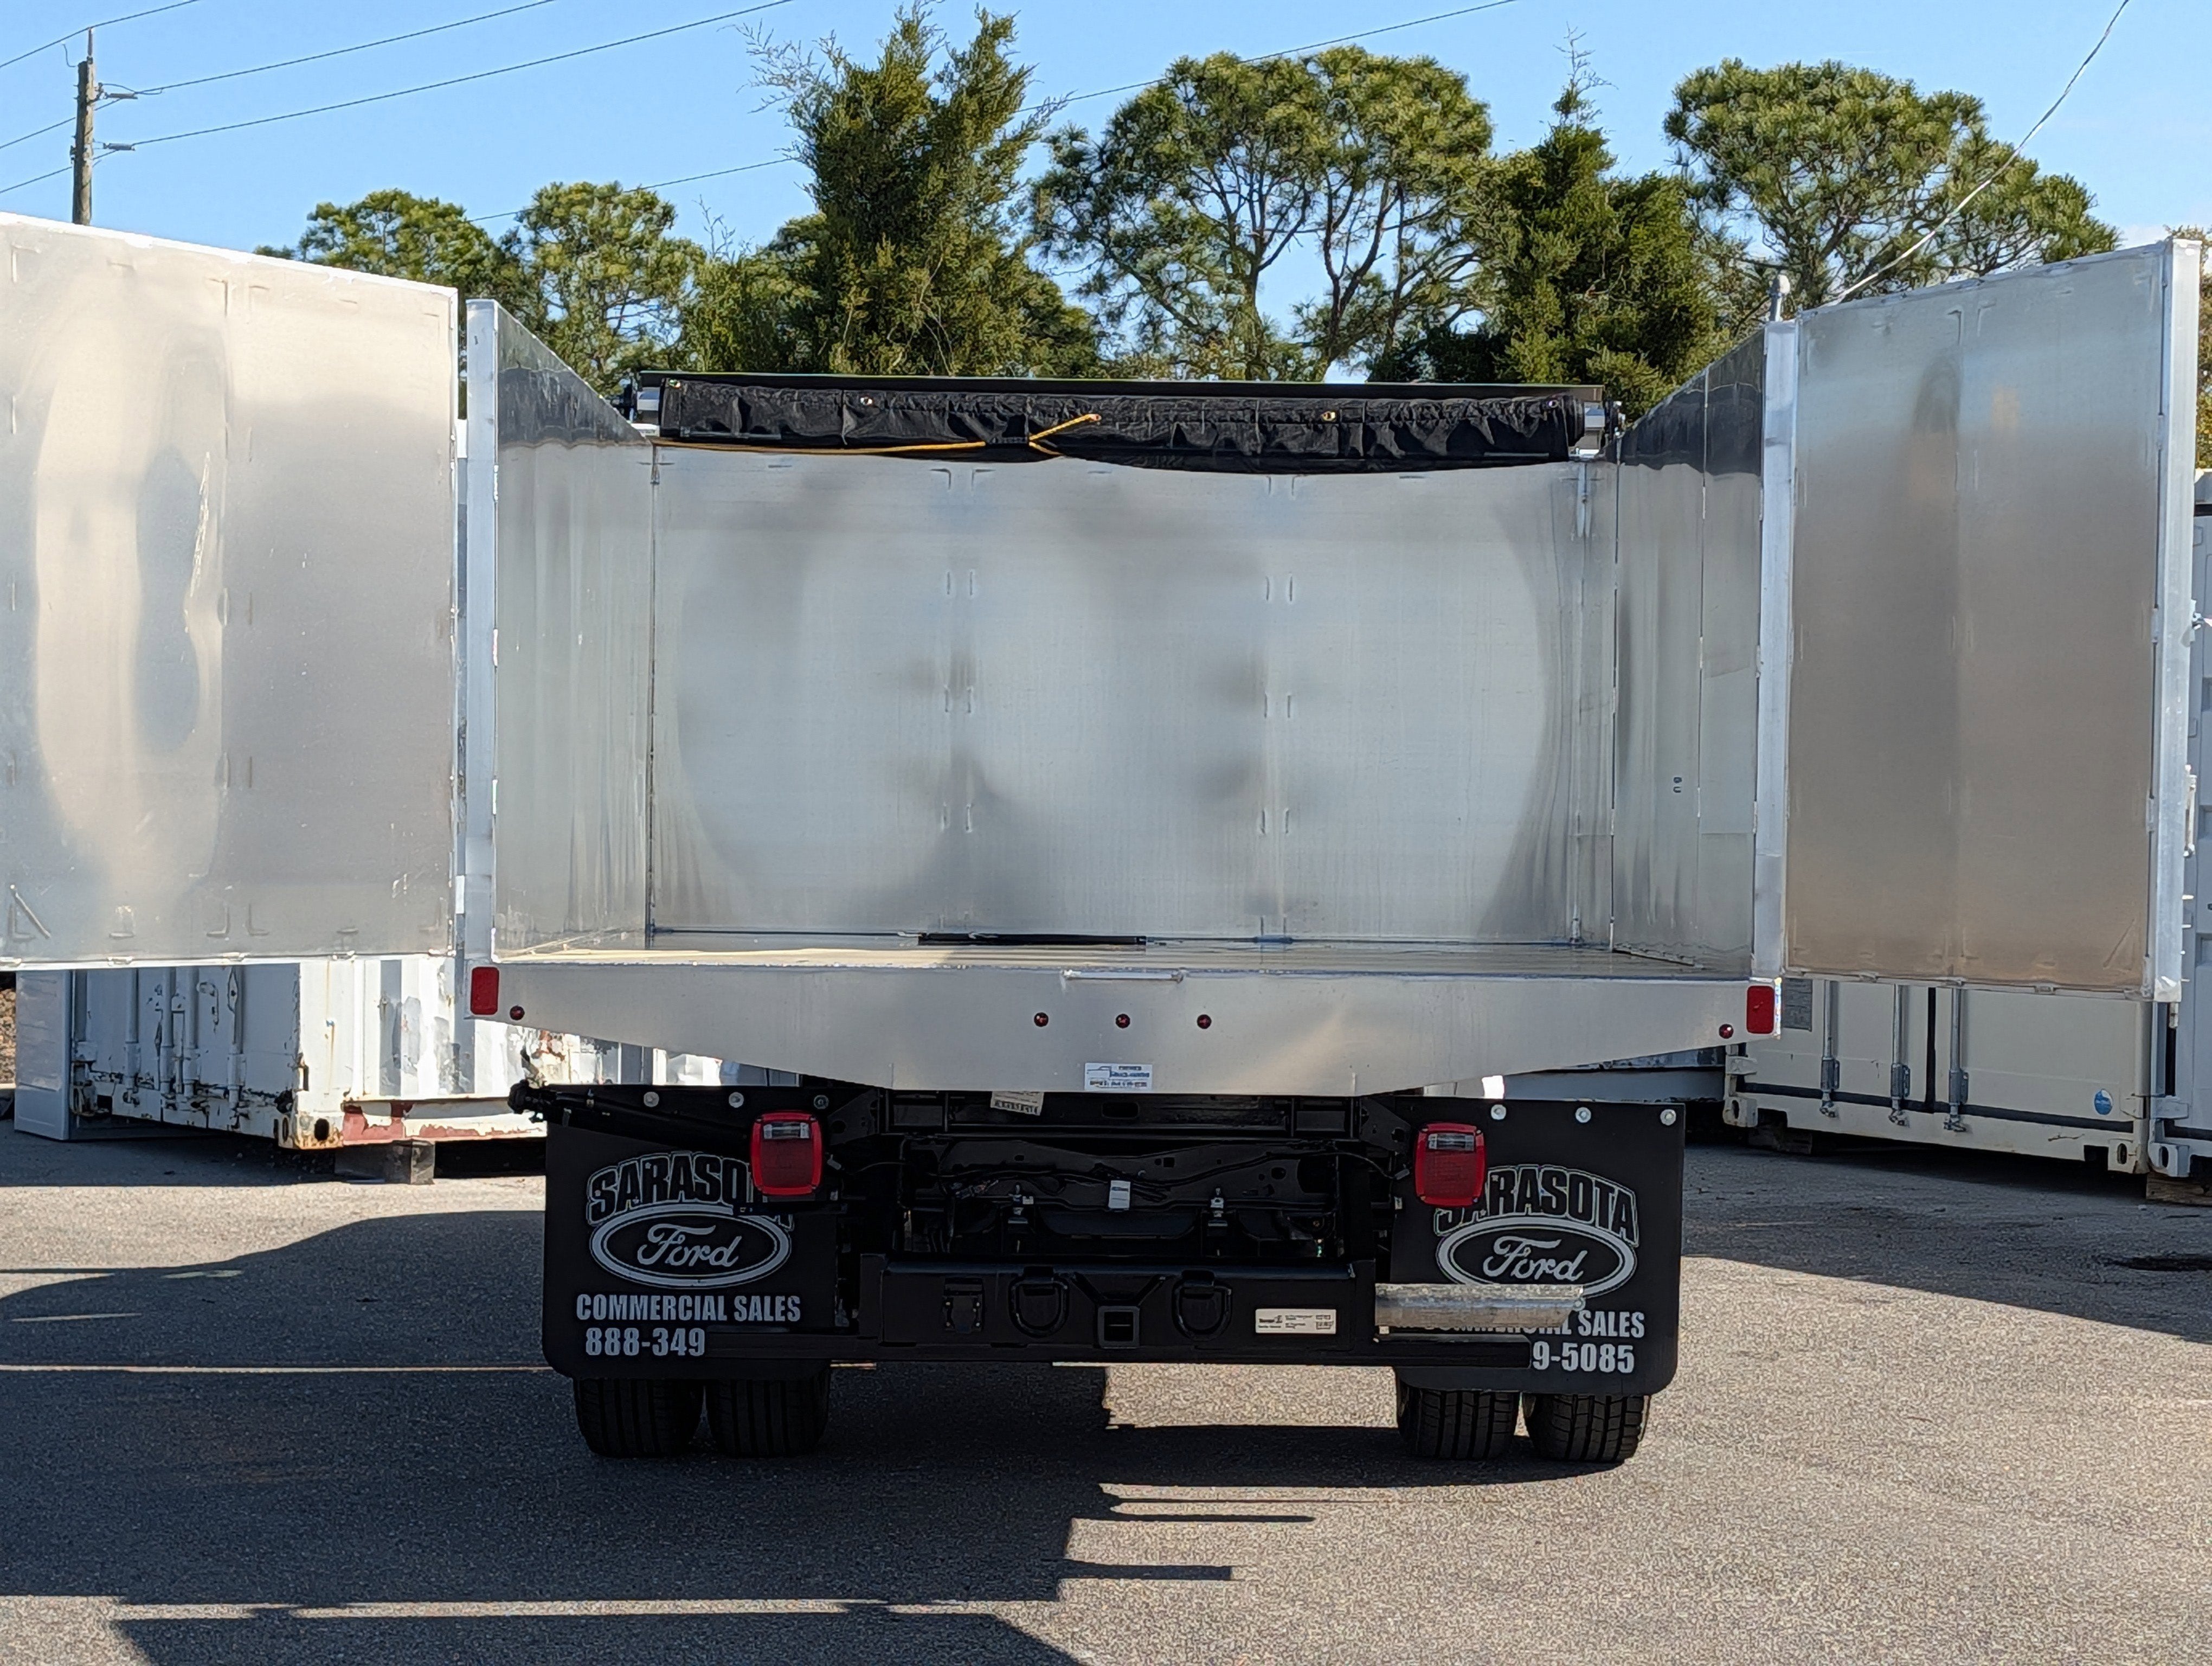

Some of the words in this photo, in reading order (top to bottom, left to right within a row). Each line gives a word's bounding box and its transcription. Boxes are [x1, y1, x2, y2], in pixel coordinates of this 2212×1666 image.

[586, 1150, 795, 1232] SARASO
[1433, 1164, 1639, 1247] RASOTA
[637, 1223, 742, 1267] Ford
[1483, 1235, 1588, 1281] Ford
[576, 1293, 727, 1321] COMMERCIAL
[734, 1295, 801, 1322] SALES
[1578, 1310, 1645, 1338] SALES
[586, 1327, 705, 1356] 888-349
[1532, 1341, 1635, 1373] 9-5085
